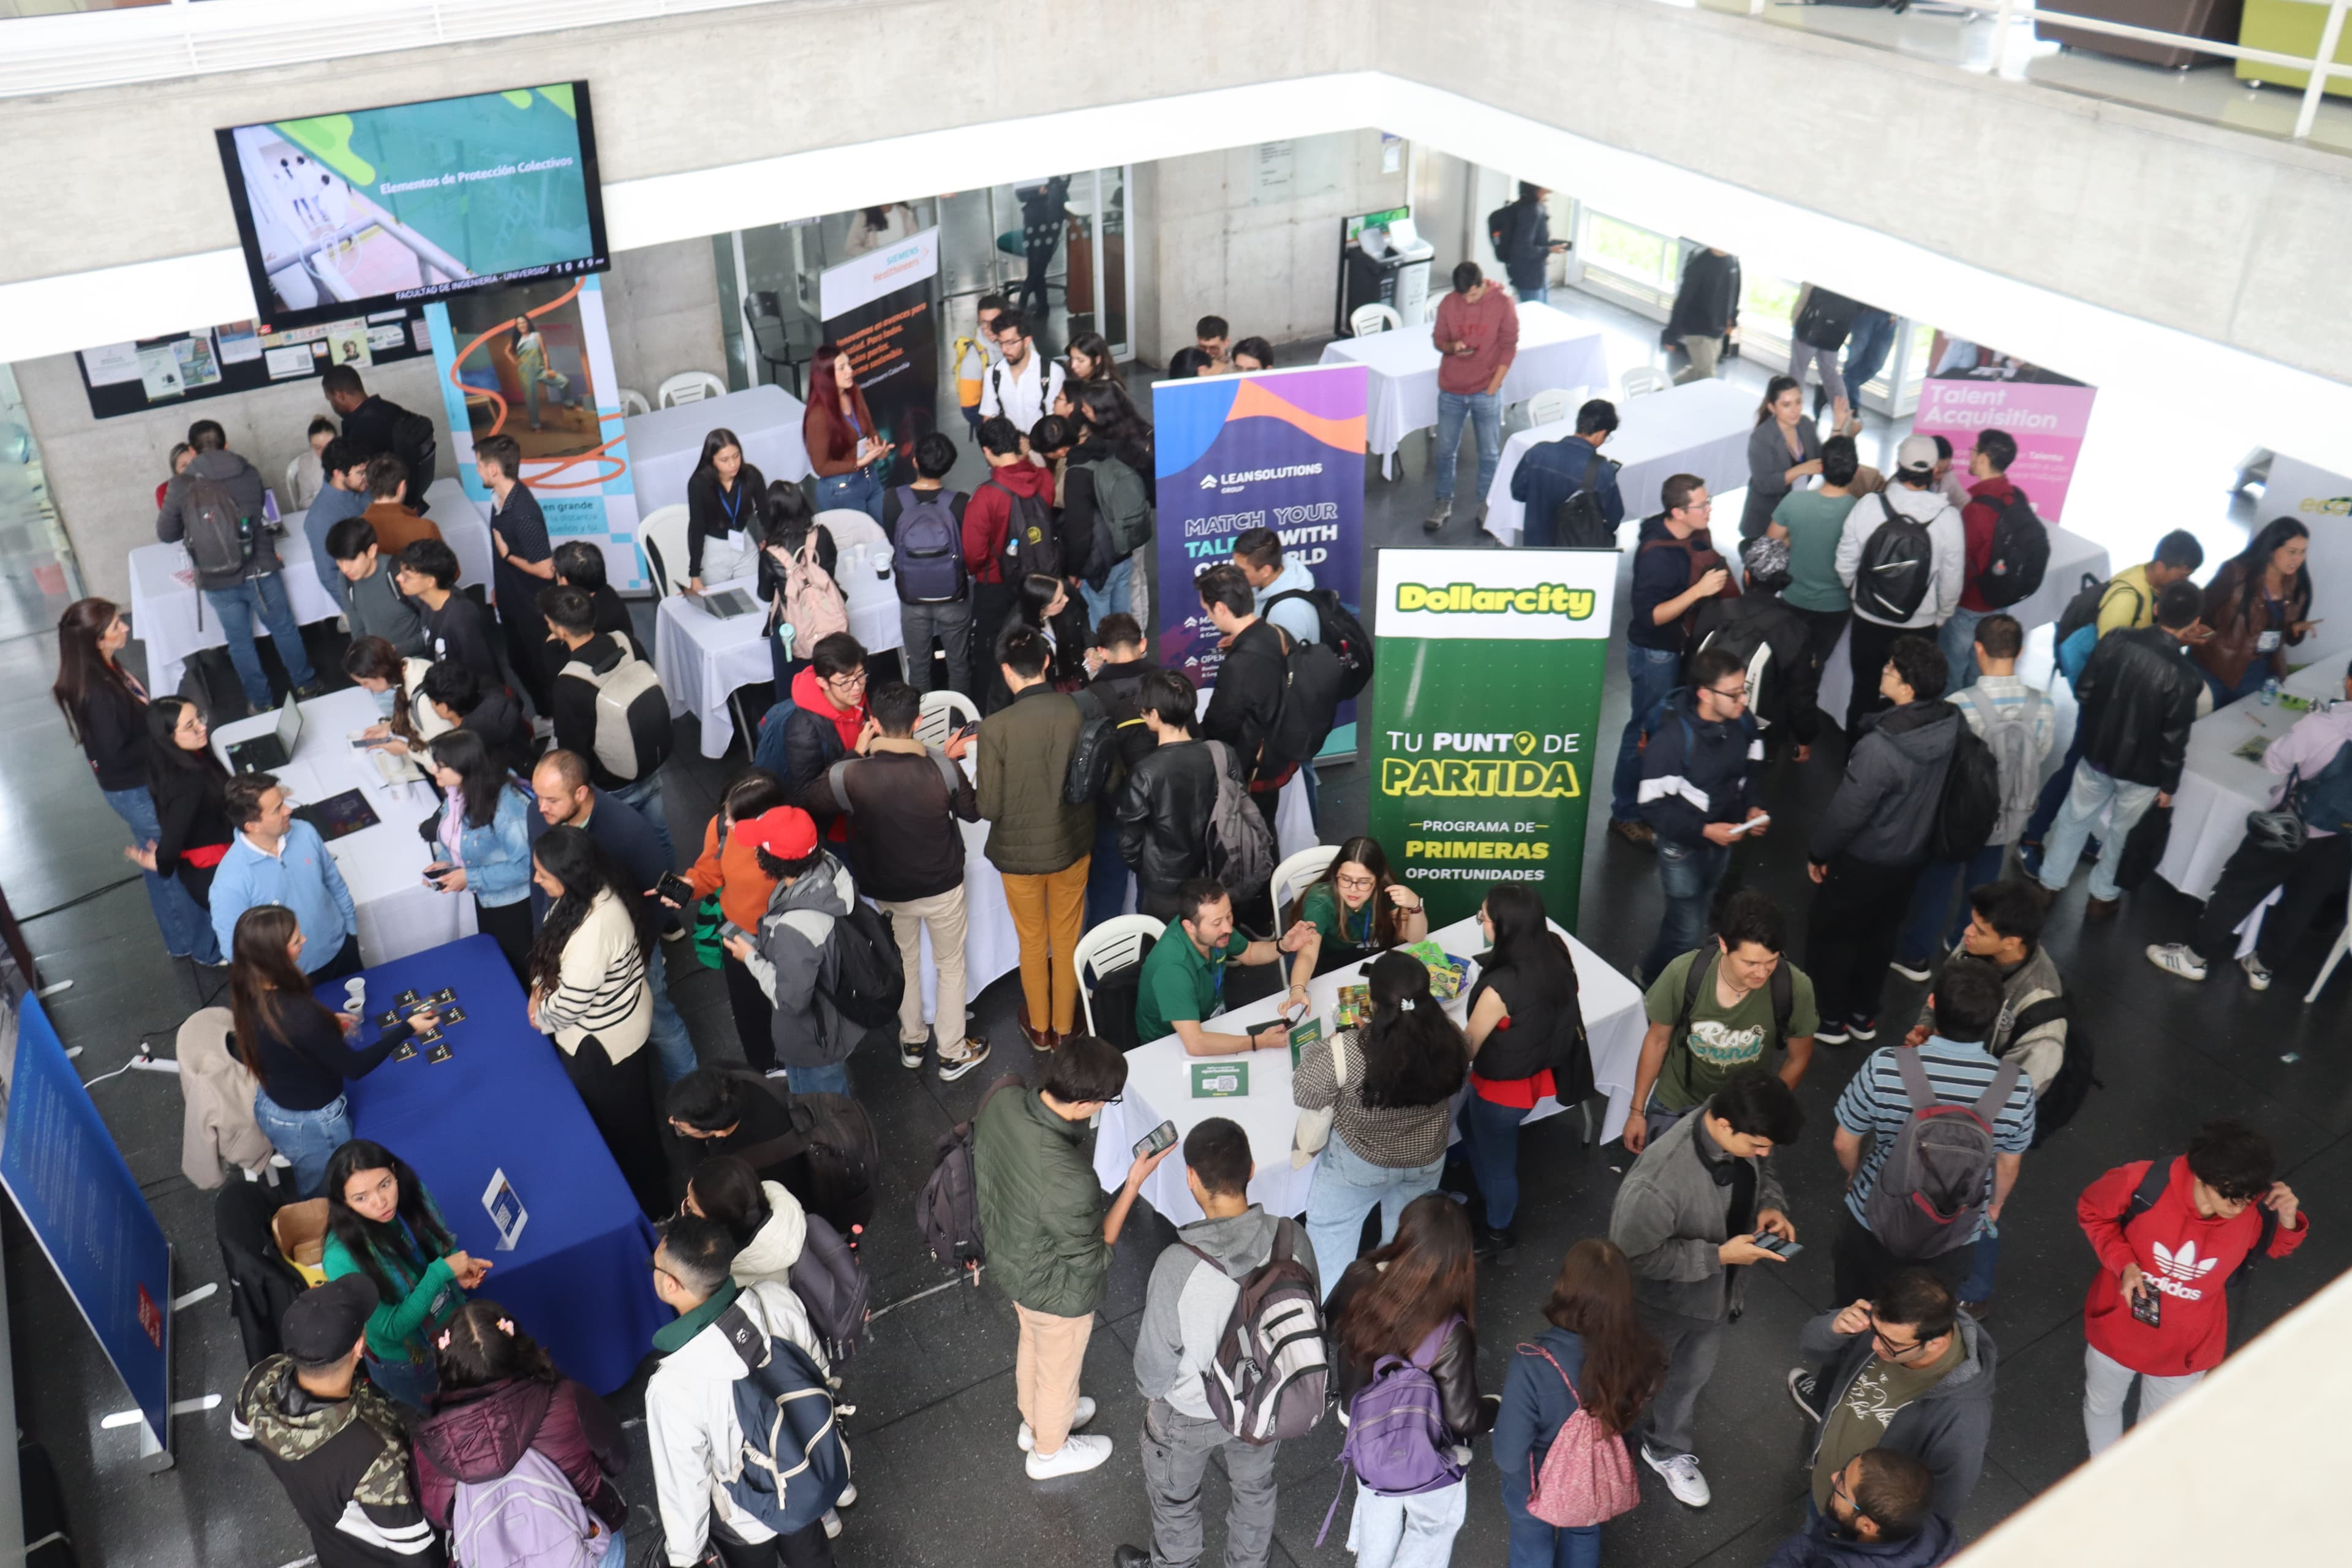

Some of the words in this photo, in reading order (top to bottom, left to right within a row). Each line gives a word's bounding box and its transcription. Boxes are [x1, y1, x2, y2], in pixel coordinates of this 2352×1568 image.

[380, 178, 440, 195] Elementos
[442, 173, 455, 184] de
[458, 165, 516, 183] Protección
[518, 157, 573, 173] Colectivos
[396, 285, 437, 300] FACULTAD
[439, 282, 451, 293] DE
[1930, 385, 2007, 405] Talent
[1924, 406, 2059, 429] Acquisition
[557, 501, 594, 513] grande
[1185, 510, 1265, 537] MATCH
[1273, 502, 1338, 526] YOUR
[1279, 524, 1338, 546] WITH
[1396, 582, 1595, 620] Dollarcity
[1387, 731, 1422, 753] TU
[1544, 733, 1580, 753] DE
[1382, 758, 1580, 797] PARTIDA
[1423, 821, 1509, 832] PROGRAMA
[1515, 821, 1535, 833] DE
[1406, 840, 1550, 859] PRIMERAS
[1406, 868, 1545, 881] OPORTUNIDADES
[1691, 1020, 1753, 1047] Rise
[2141, 1272, 2202, 1300] adidas
